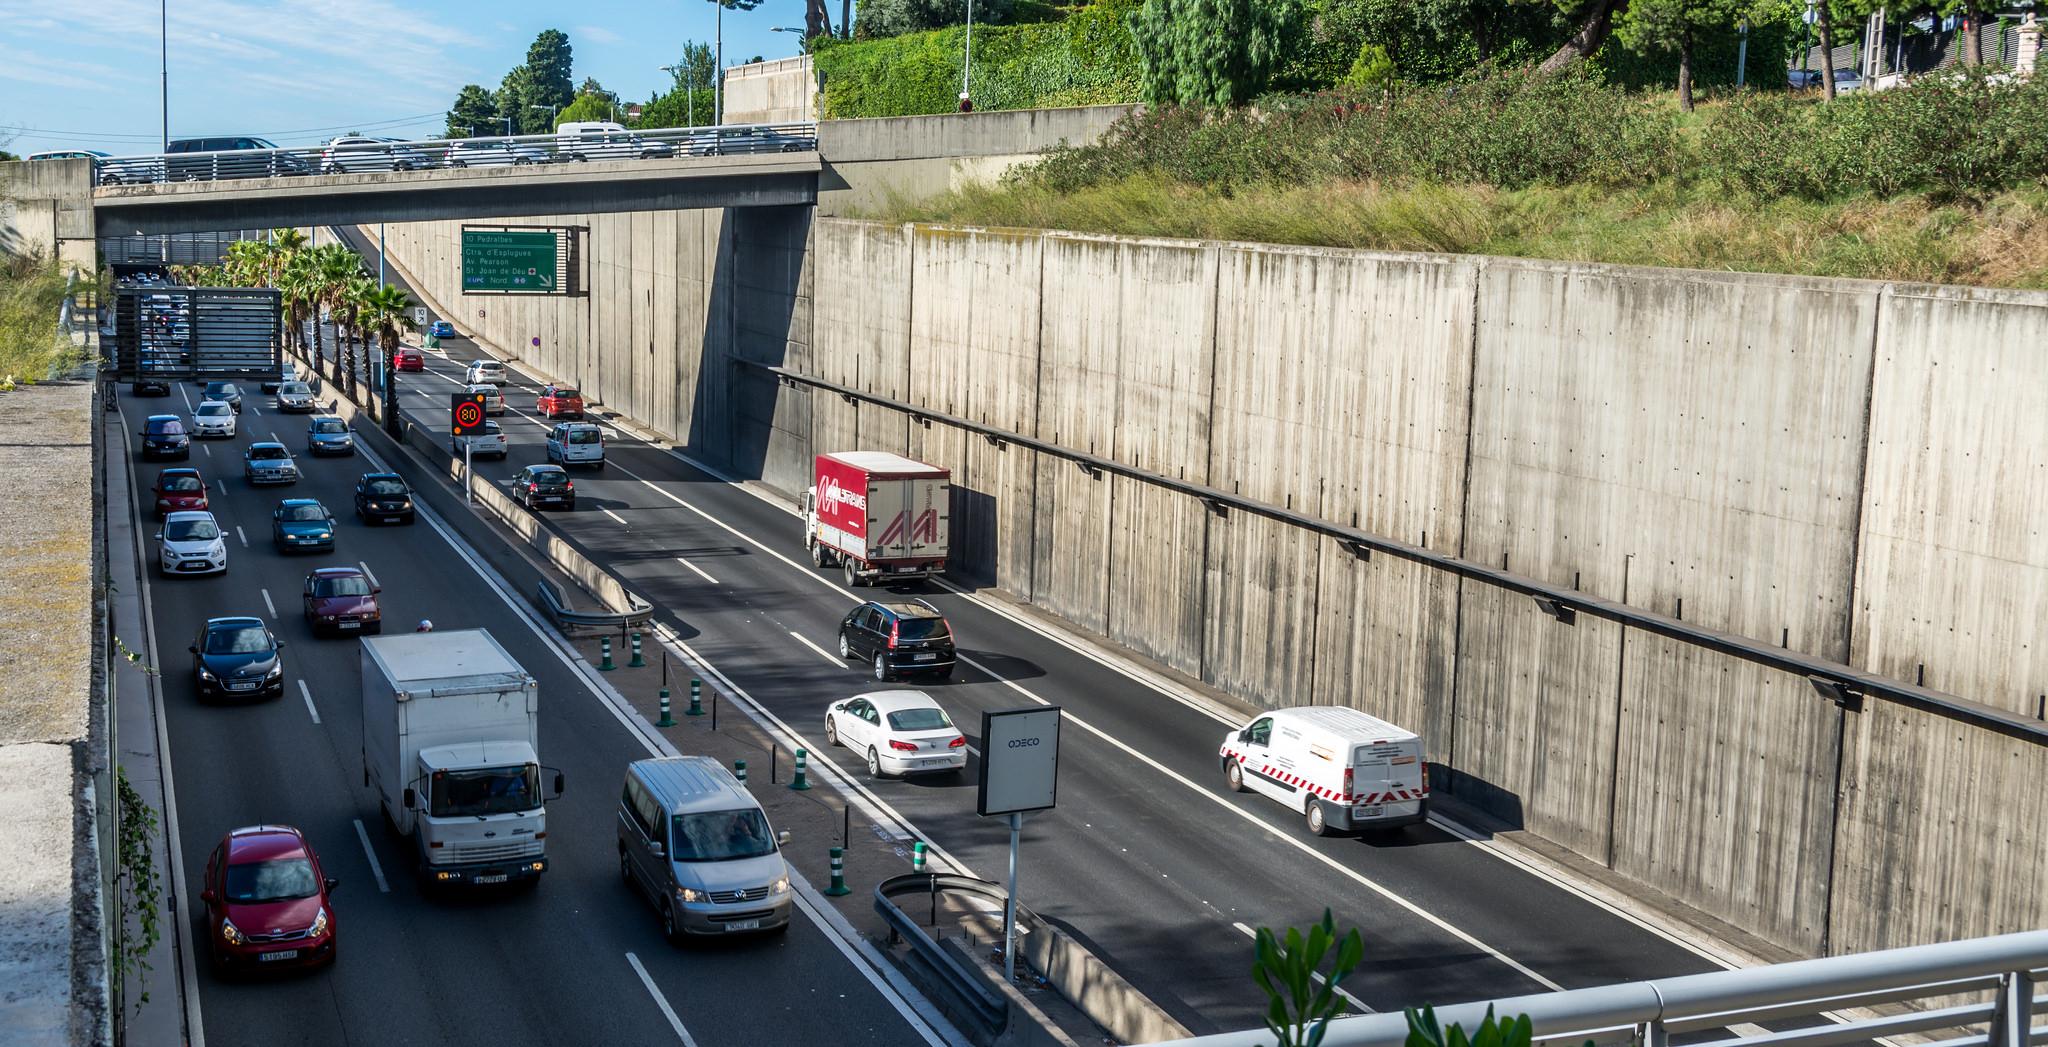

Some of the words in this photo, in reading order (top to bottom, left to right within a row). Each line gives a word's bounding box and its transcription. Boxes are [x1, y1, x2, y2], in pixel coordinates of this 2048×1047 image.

[487, 249, 532, 257] d'Esplugues
[461, 408, 476, 420] 80
[1008, 737, 1040, 749] ODECO
